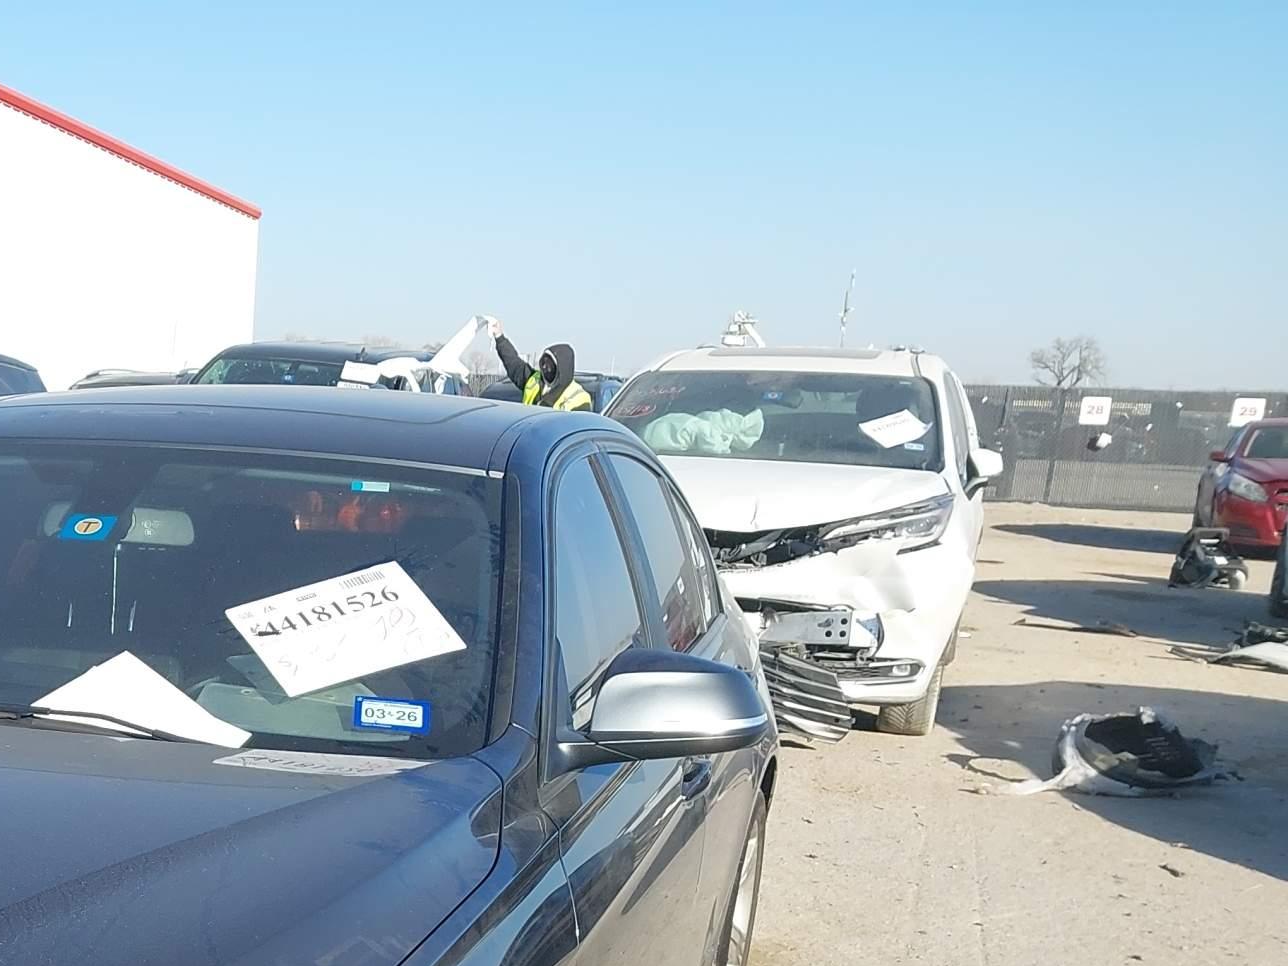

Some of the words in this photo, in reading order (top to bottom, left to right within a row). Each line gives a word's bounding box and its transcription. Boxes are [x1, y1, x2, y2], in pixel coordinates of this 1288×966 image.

[1087, 405, 1103, 415] 28
[1240, 407, 1257, 416] 29
[257, 585, 400, 636] 44181526
